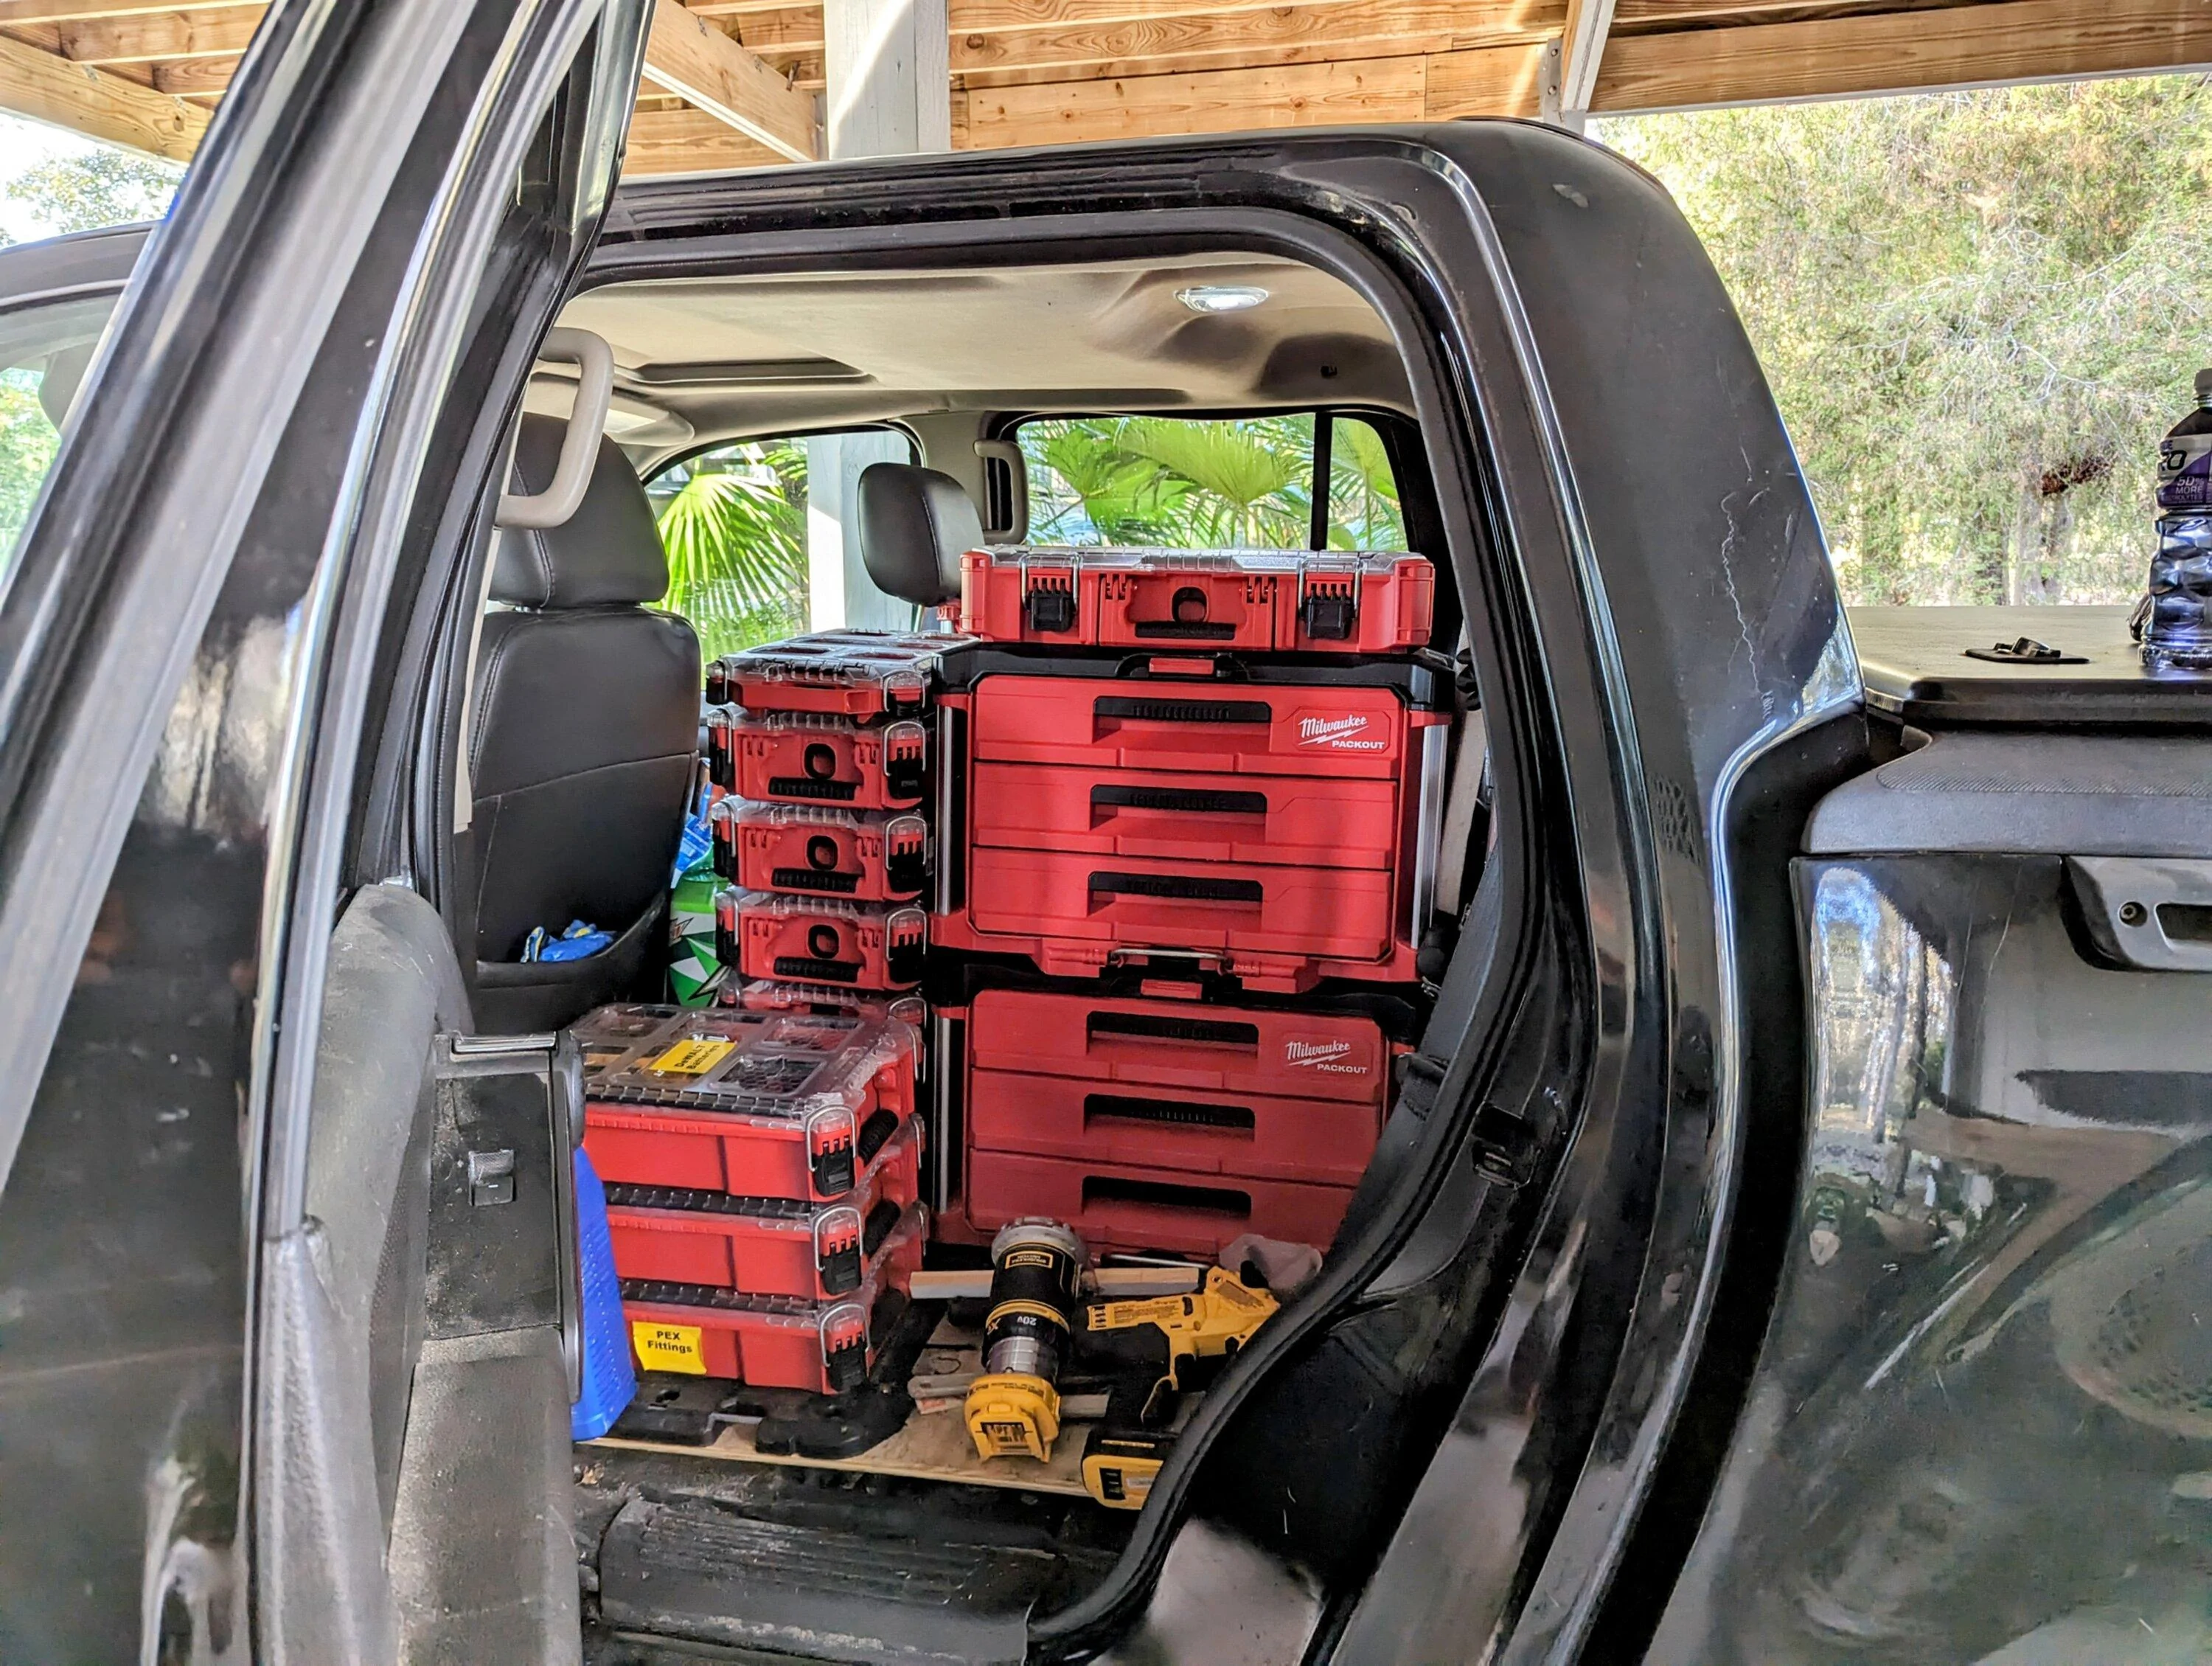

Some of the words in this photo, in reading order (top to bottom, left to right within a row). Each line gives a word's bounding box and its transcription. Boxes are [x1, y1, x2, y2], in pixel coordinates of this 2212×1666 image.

[1298, 715, 1368, 738] Milwaukee
[1332, 740, 1385, 749] PACKOUT
[1285, 1041, 1350, 1060] Milwaukee
[1317, 1063, 1367, 1074] PACKOUT
[656, 1330, 681, 1340] PEX
[647, 1340, 692, 1353] Fittings
